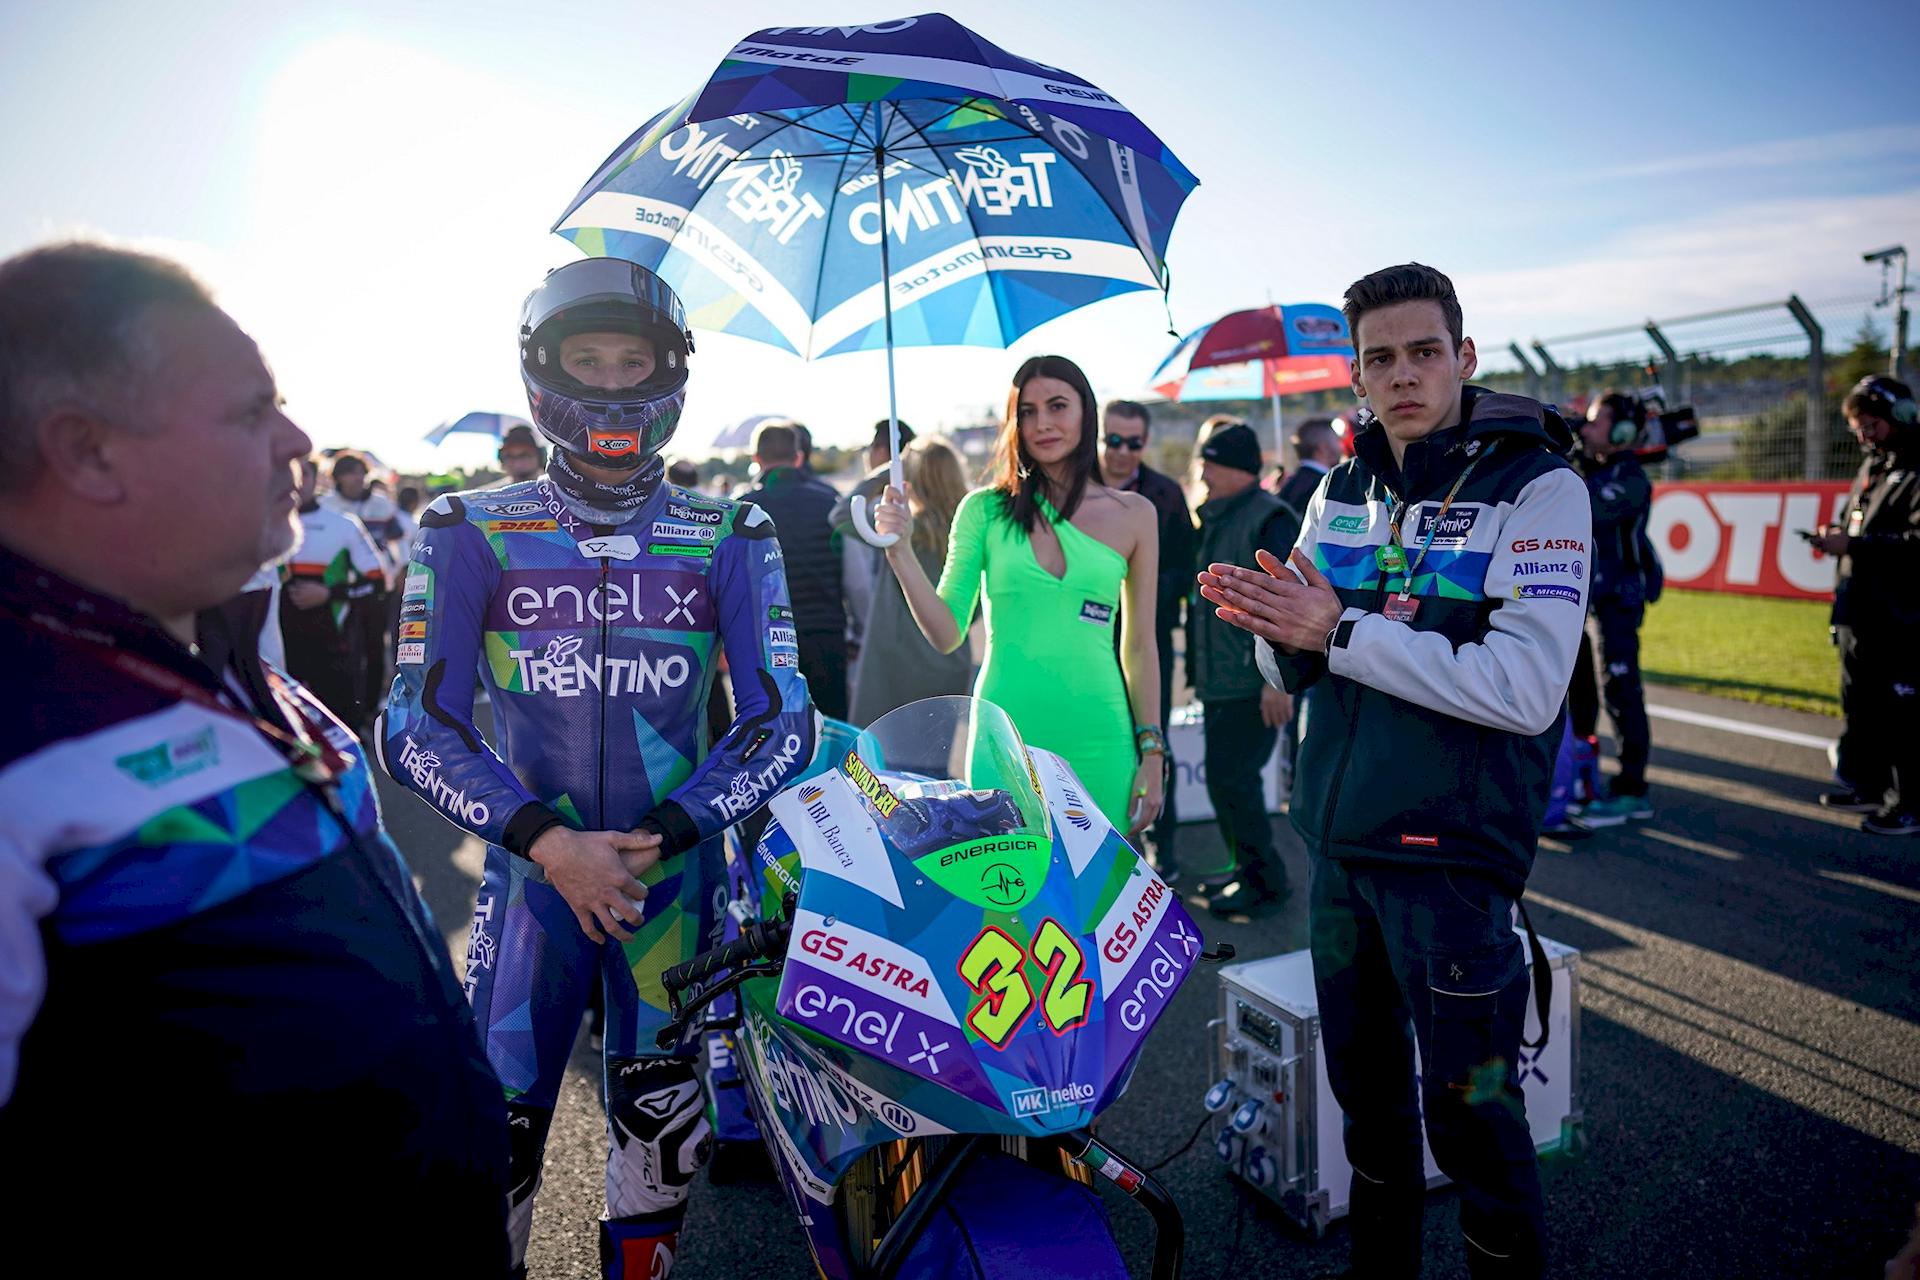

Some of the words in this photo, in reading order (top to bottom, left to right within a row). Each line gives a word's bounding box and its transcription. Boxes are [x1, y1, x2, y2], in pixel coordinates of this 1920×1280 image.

[498, 521, 548, 531] DHL
[653, 525, 696, 536] Allianz
[1511, 539, 1540, 553] GS
[1543, 539, 1585, 553] ASTRA
[1647, 489, 1850, 593] OTU
[507, 573, 644, 626] enel
[1513, 561, 1568, 577] Allianz
[1536, 588, 1579, 601] MICHELIN
[509, 650, 689, 698] TRENTINO
[398, 734, 490, 826] TRENTINO
[710, 733, 801, 821] TRENTINO
[844, 752, 900, 818] SAVADORI
[807, 800, 825, 829] IBL
[823, 824, 853, 869] Banca
[1103, 922, 1137, 964] GS
[1132, 878, 1166, 932] ASTRA
[801, 930, 848, 962] GS
[846, 952, 930, 998] ASTRA
[957, 916, 1095, 1051] 32
[1120, 941, 1183, 1032] enel
[795, 985, 904, 1054] enel
[1051, 1081, 1095, 1104] neiko
